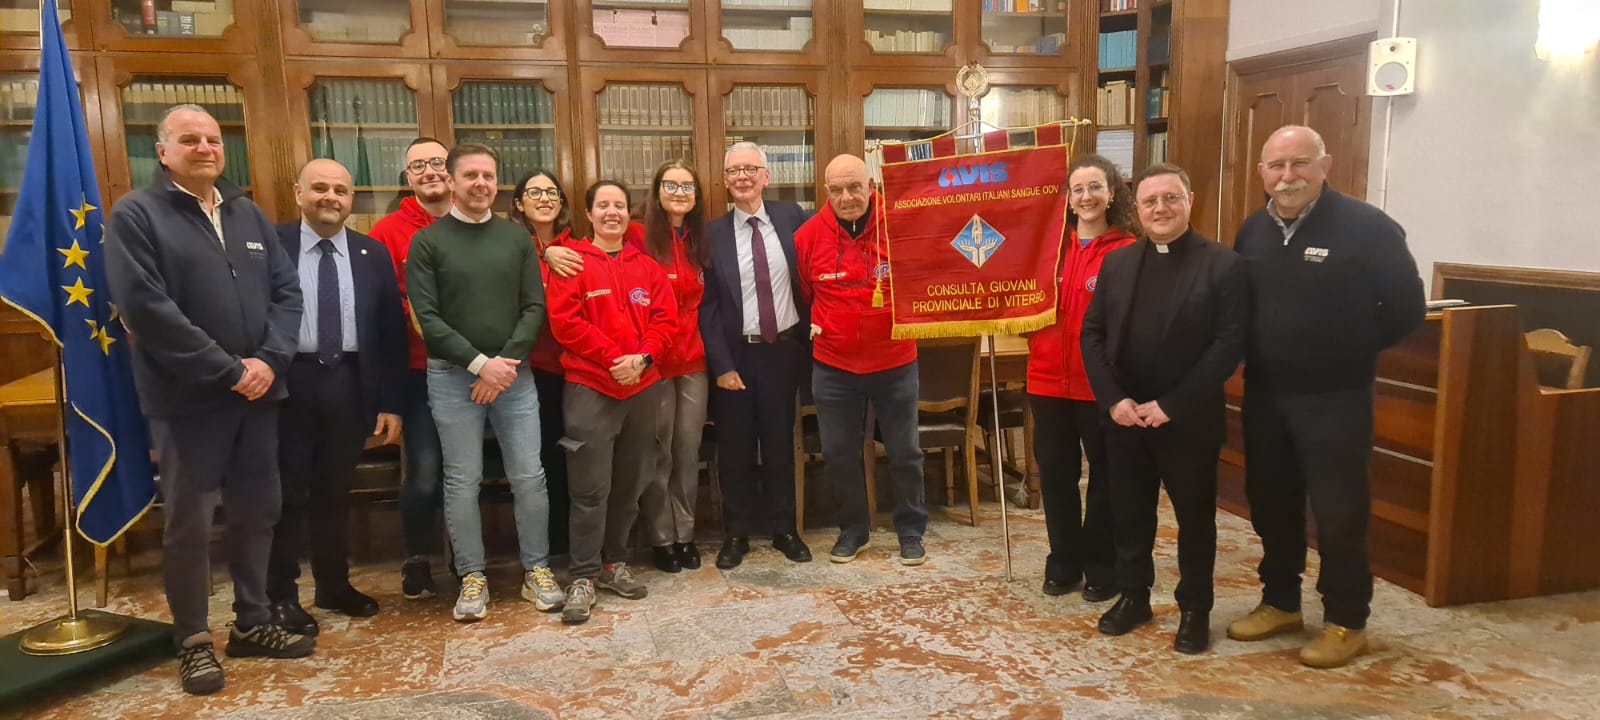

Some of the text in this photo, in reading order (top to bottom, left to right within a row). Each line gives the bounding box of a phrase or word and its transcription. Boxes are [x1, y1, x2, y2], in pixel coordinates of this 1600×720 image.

[939, 163, 1008, 187] AVIS
[894, 185, 1059, 209] ASSOCIAZIONE VOLONTARI ITALIANI SANGUE ODV
[927, 279, 1037, 296] CONSULTA GIOVANI
[912, 290, 1046, 312] PROVINCIALE DI VITERBO
